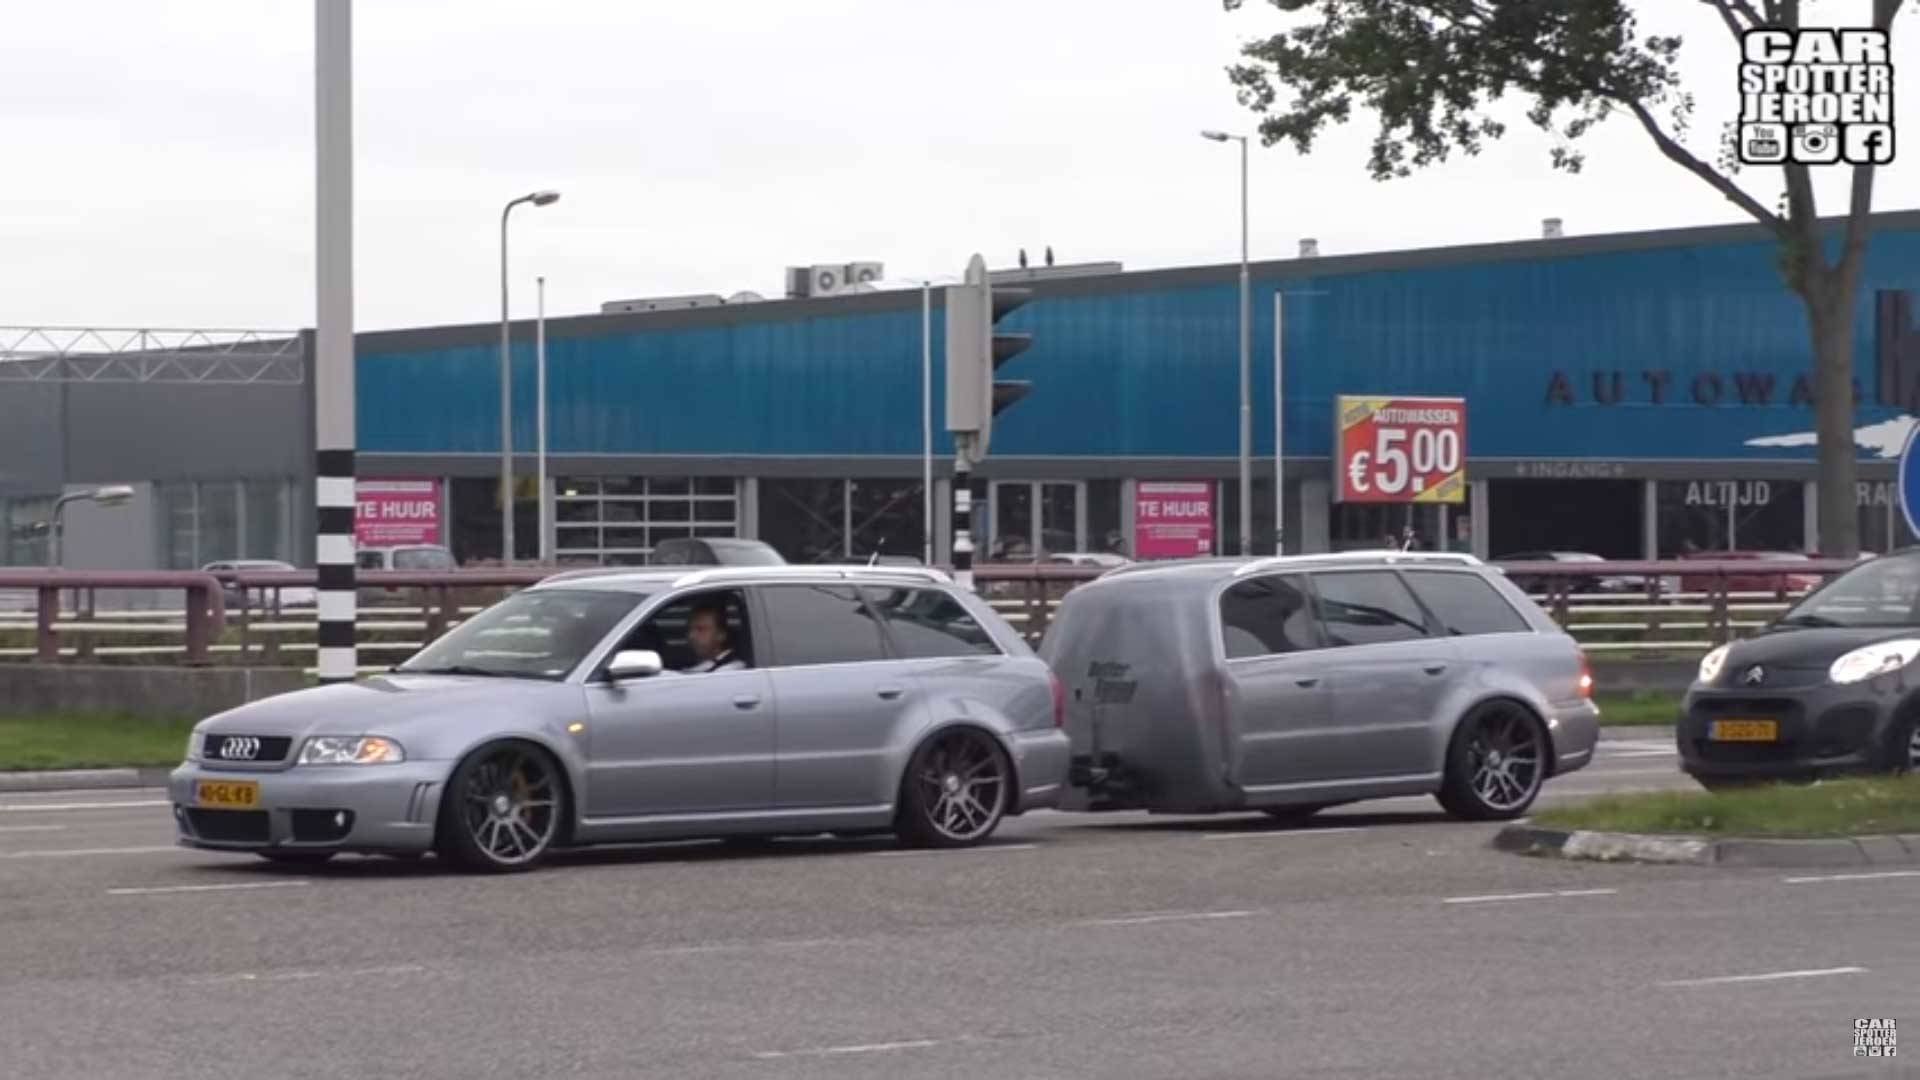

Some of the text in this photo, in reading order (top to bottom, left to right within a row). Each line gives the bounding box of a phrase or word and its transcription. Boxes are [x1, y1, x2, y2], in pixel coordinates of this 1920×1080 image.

[1373, 408, 1458, 424] AUTOWASSEN
[1532, 462, 1609, 478] INGANG
[1685, 481, 1770, 506] ALTIJD
[355, 501, 436, 518] TE HUUR
[1139, 501, 1209, 517] TE HUUR
